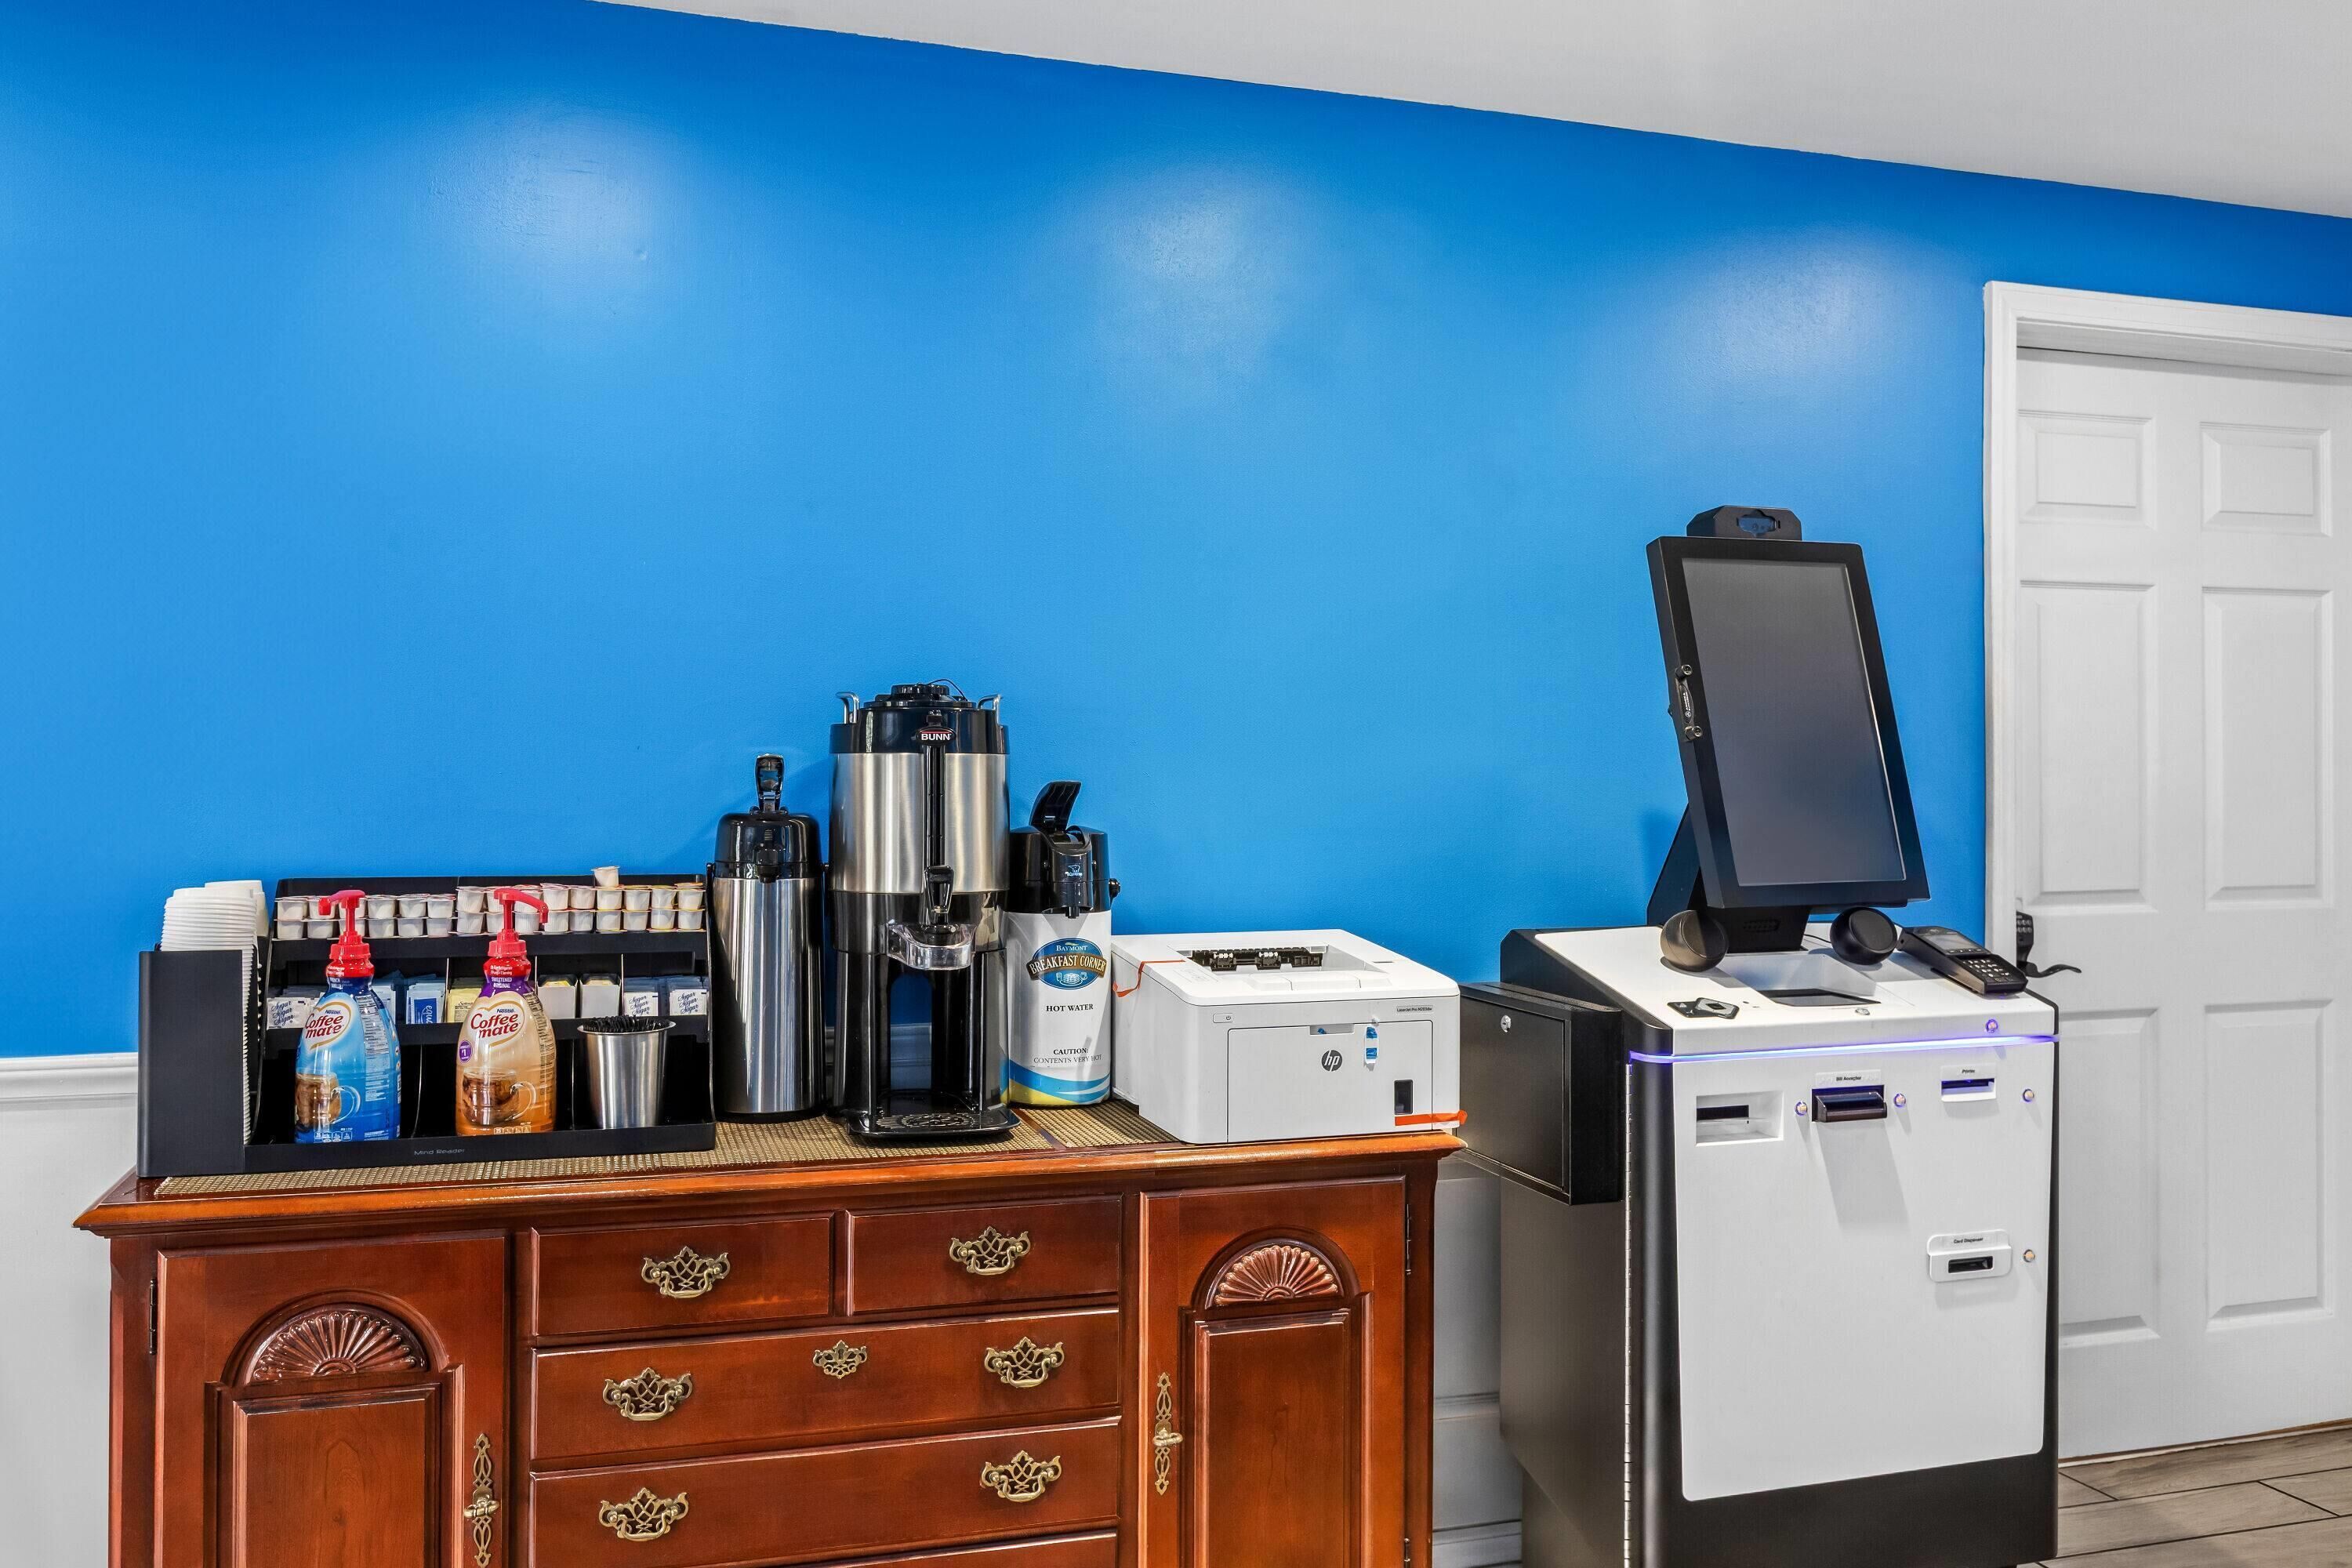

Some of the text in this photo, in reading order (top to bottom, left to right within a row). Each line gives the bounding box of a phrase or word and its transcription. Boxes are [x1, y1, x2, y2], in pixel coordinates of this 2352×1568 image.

[1029, 955, 1106, 975] BREAKFAST CORNER
[271, 1000, 293, 1014] Sugar
[272, 1007, 294, 1021] Sugar
[423, 1005, 433, 1023] equ
[274, 1014, 295, 1027] Sugar
[305, 1012, 344, 1029] Coffee
[470, 1013, 519, 1029] Coffee
[305, 1024, 343, 1039] mate
[479, 1022, 519, 1039] mate
[1323, 1050, 1341, 1072] hp
